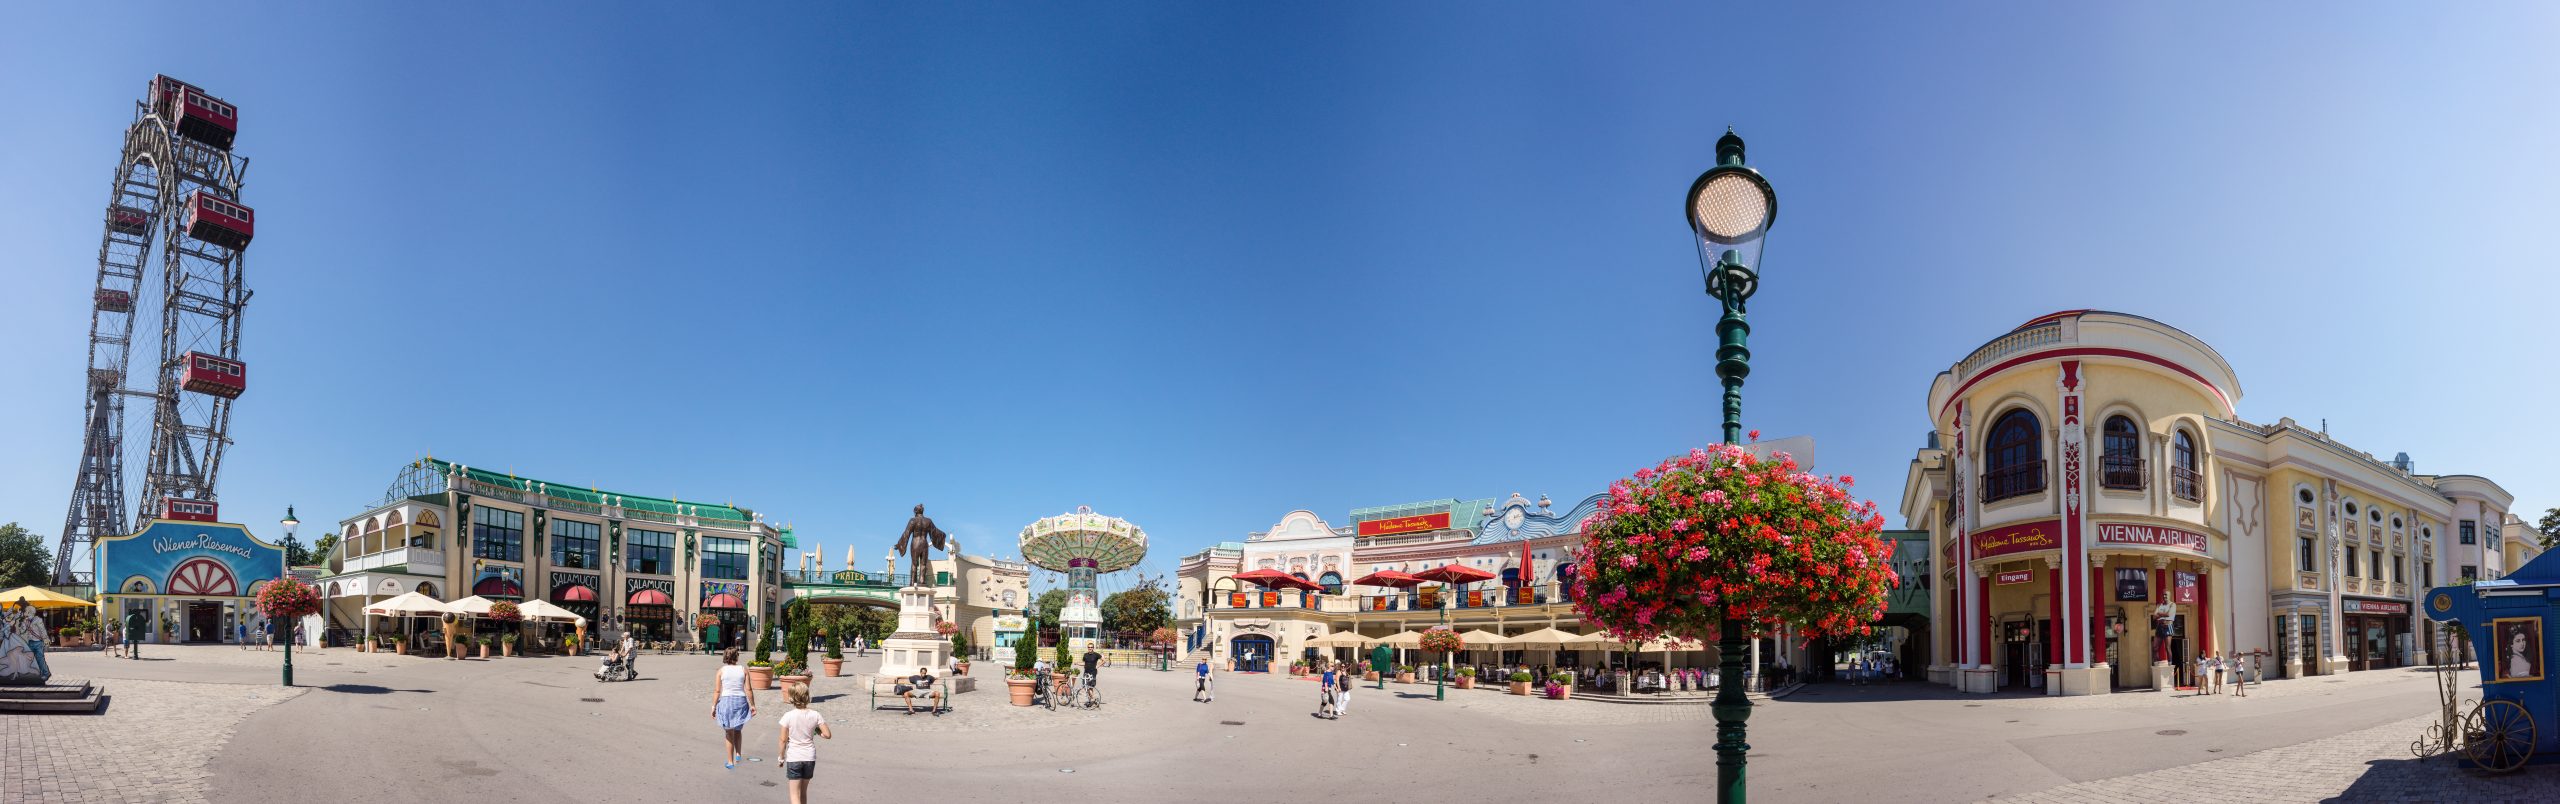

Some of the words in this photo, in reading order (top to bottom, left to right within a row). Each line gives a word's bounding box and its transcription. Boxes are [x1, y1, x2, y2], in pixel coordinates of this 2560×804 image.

[1380, 520, 1403, 531] Madame
[152, 536, 198, 554] Wiener
[197, 533, 252, 559] Riesenrad
[1980, 536, 2009, 550] Madame
[2008, 528, 2047, 546] Tussauds
[2100, 525, 2155, 543] VIENNA
[2158, 529, 2206, 551] AIRLINES
[552, 572, 598, 591] SALAMUCCI
[835, 571, 865, 580] PRATER
[2001, 573, 2028, 582] Eingang
[628, 579, 673, 595] SALAMUCCI
[2380, 603, 2400, 611] AIRLINES
